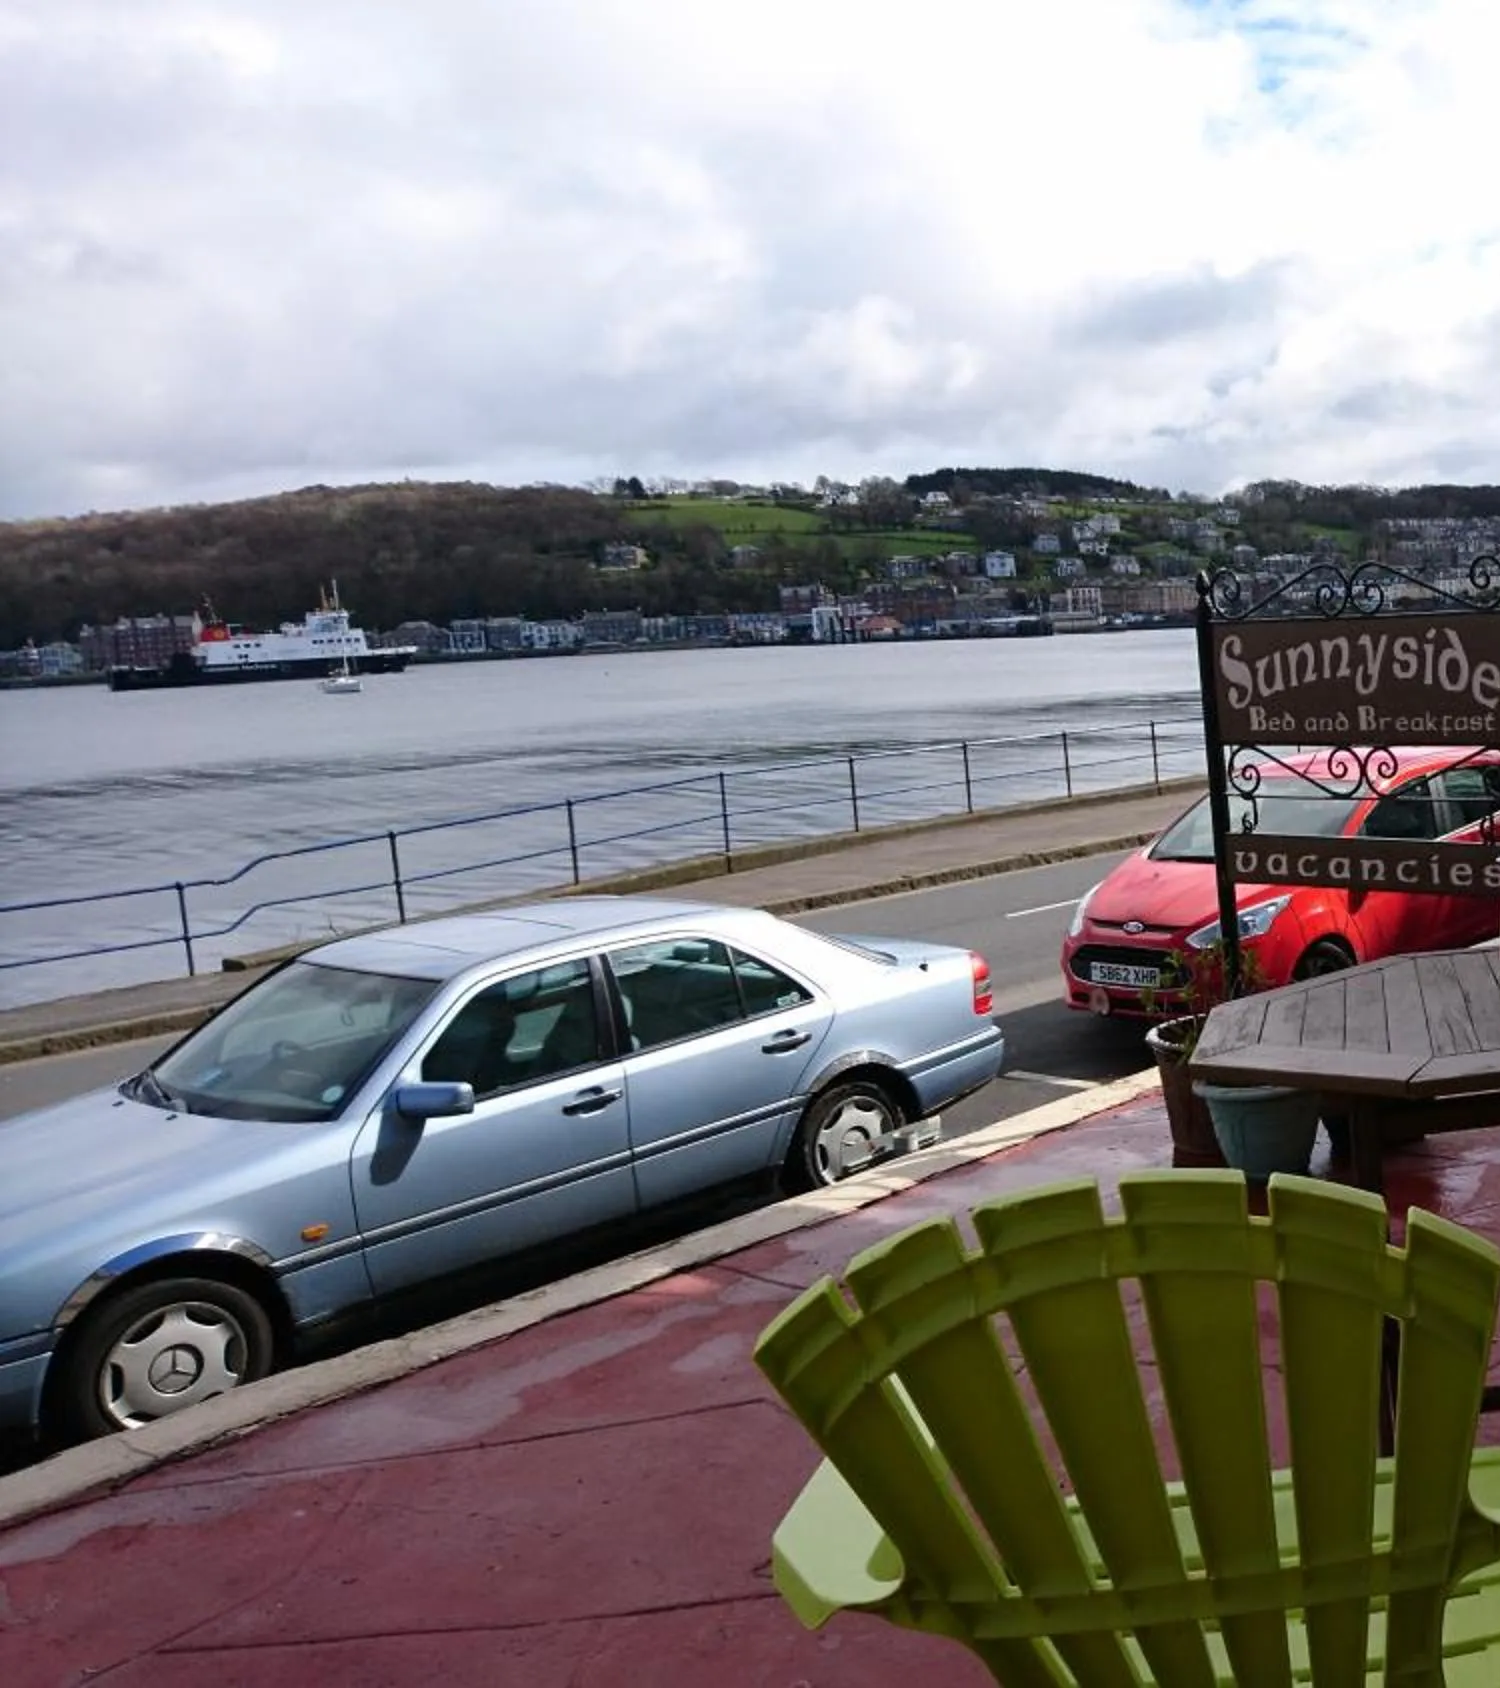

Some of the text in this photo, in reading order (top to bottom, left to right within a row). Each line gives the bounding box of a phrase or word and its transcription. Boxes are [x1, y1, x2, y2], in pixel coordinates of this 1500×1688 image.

[1249, 704, 1498, 736] Bed and Breakfast
[1099, 964, 1157, 985] SB62 XHR
